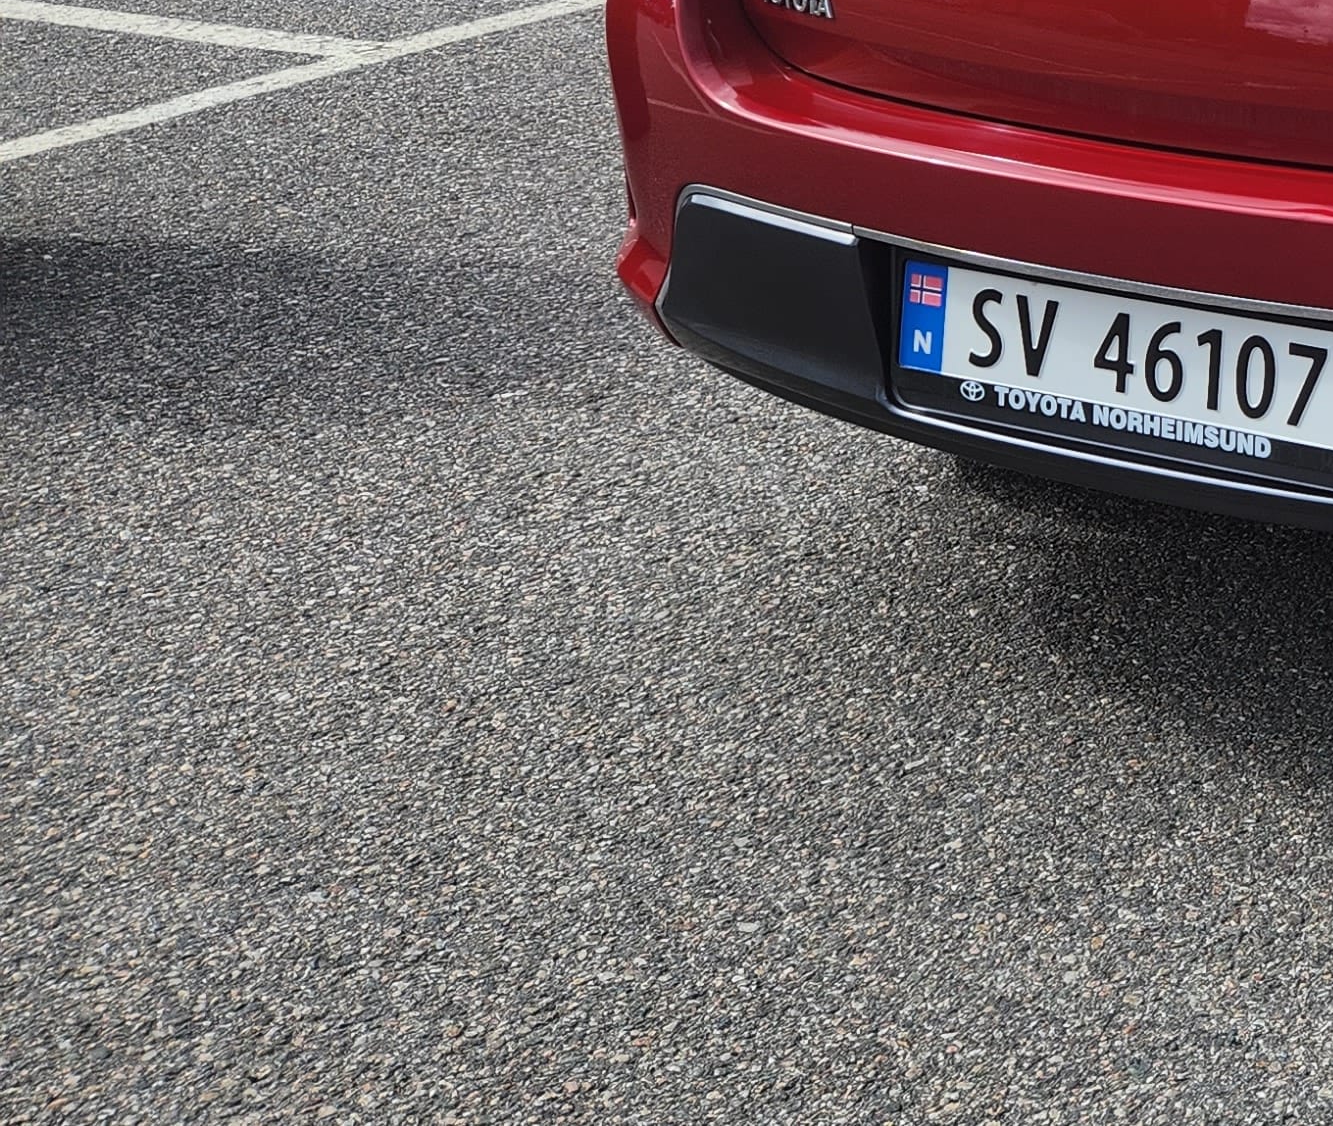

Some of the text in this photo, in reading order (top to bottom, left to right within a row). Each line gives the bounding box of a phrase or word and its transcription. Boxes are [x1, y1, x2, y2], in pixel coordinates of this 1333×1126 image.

[912, 329, 933, 355] N
[968, 288, 1329, 427] SV 46107
[994, 385, 1273, 460] TOYOTA NORHEIMSUND
